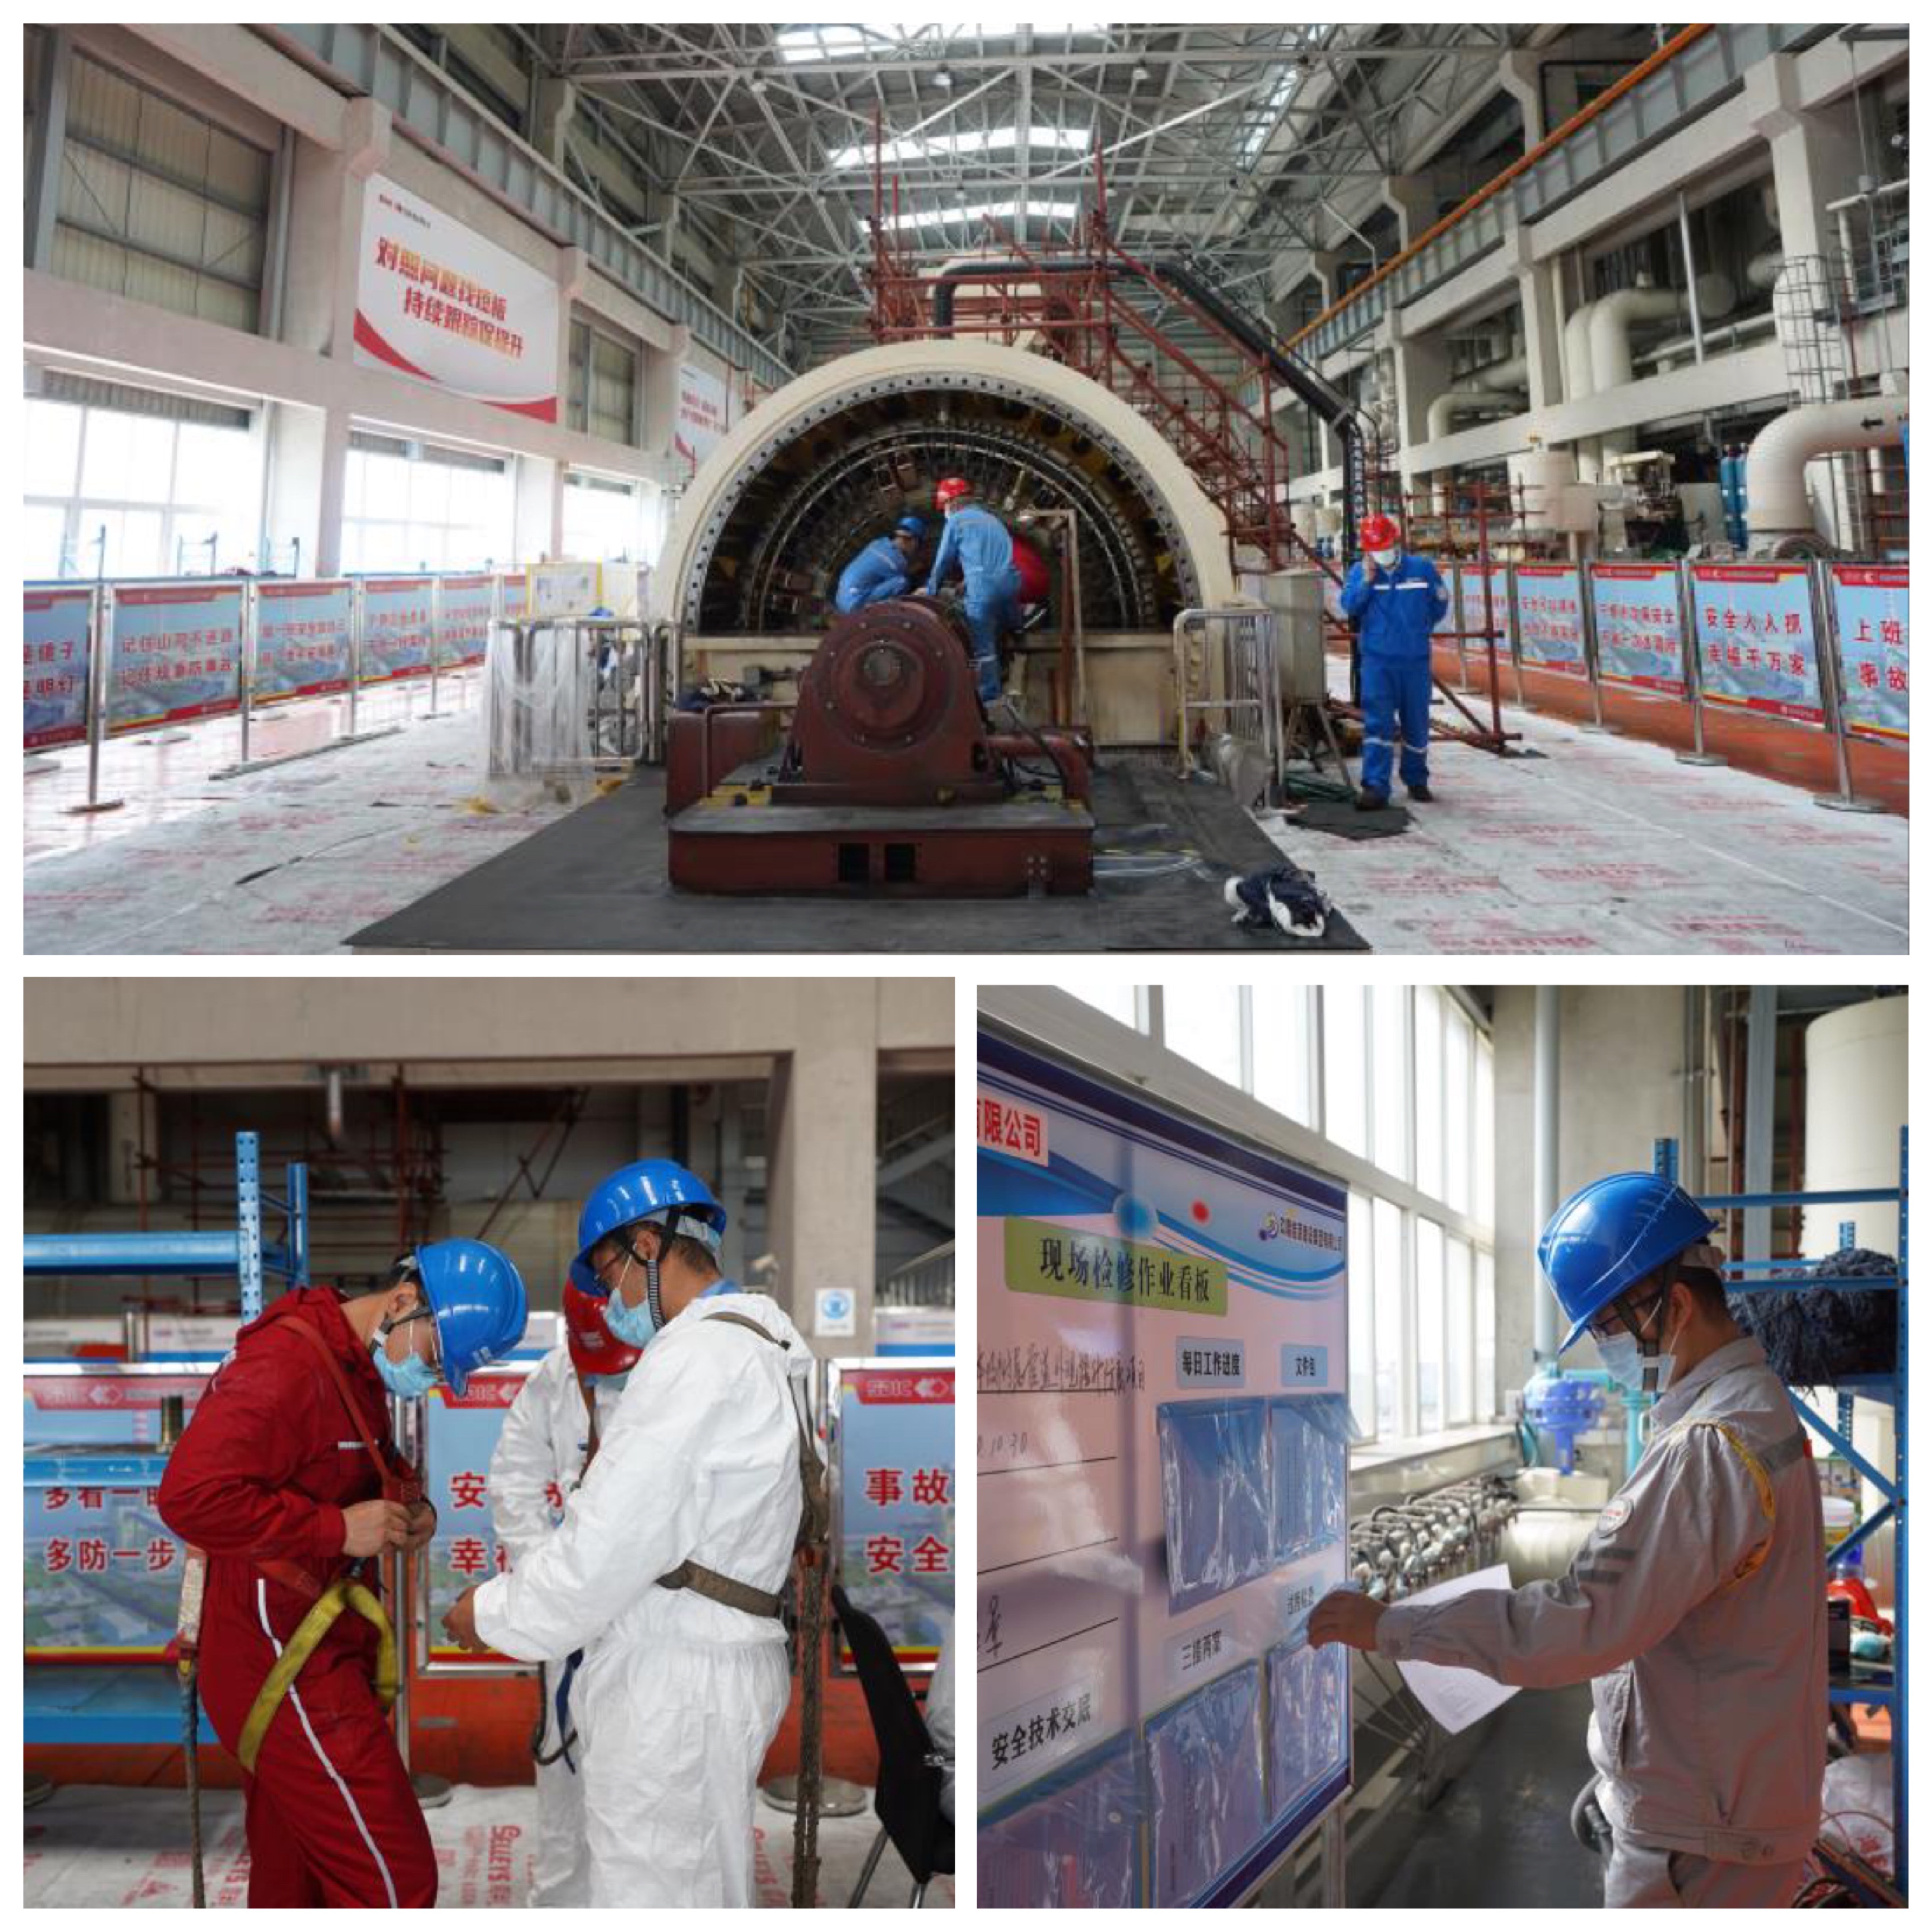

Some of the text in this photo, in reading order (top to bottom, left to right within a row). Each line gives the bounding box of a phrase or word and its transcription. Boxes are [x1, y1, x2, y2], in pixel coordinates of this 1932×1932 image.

[1040, 1237, 1210, 1302] 现场检修作业看板
[1182, 1350, 1241, 1377] 每日工作进度
[44, 1487, 160, 1509] 多看一
[865, 1469, 949, 1506] 事故
[45, 1538, 176, 1572] 多防一步
[866, 1535, 951, 1573] 安全
[991, 1693, 1091, 1771] 安全技术交底
